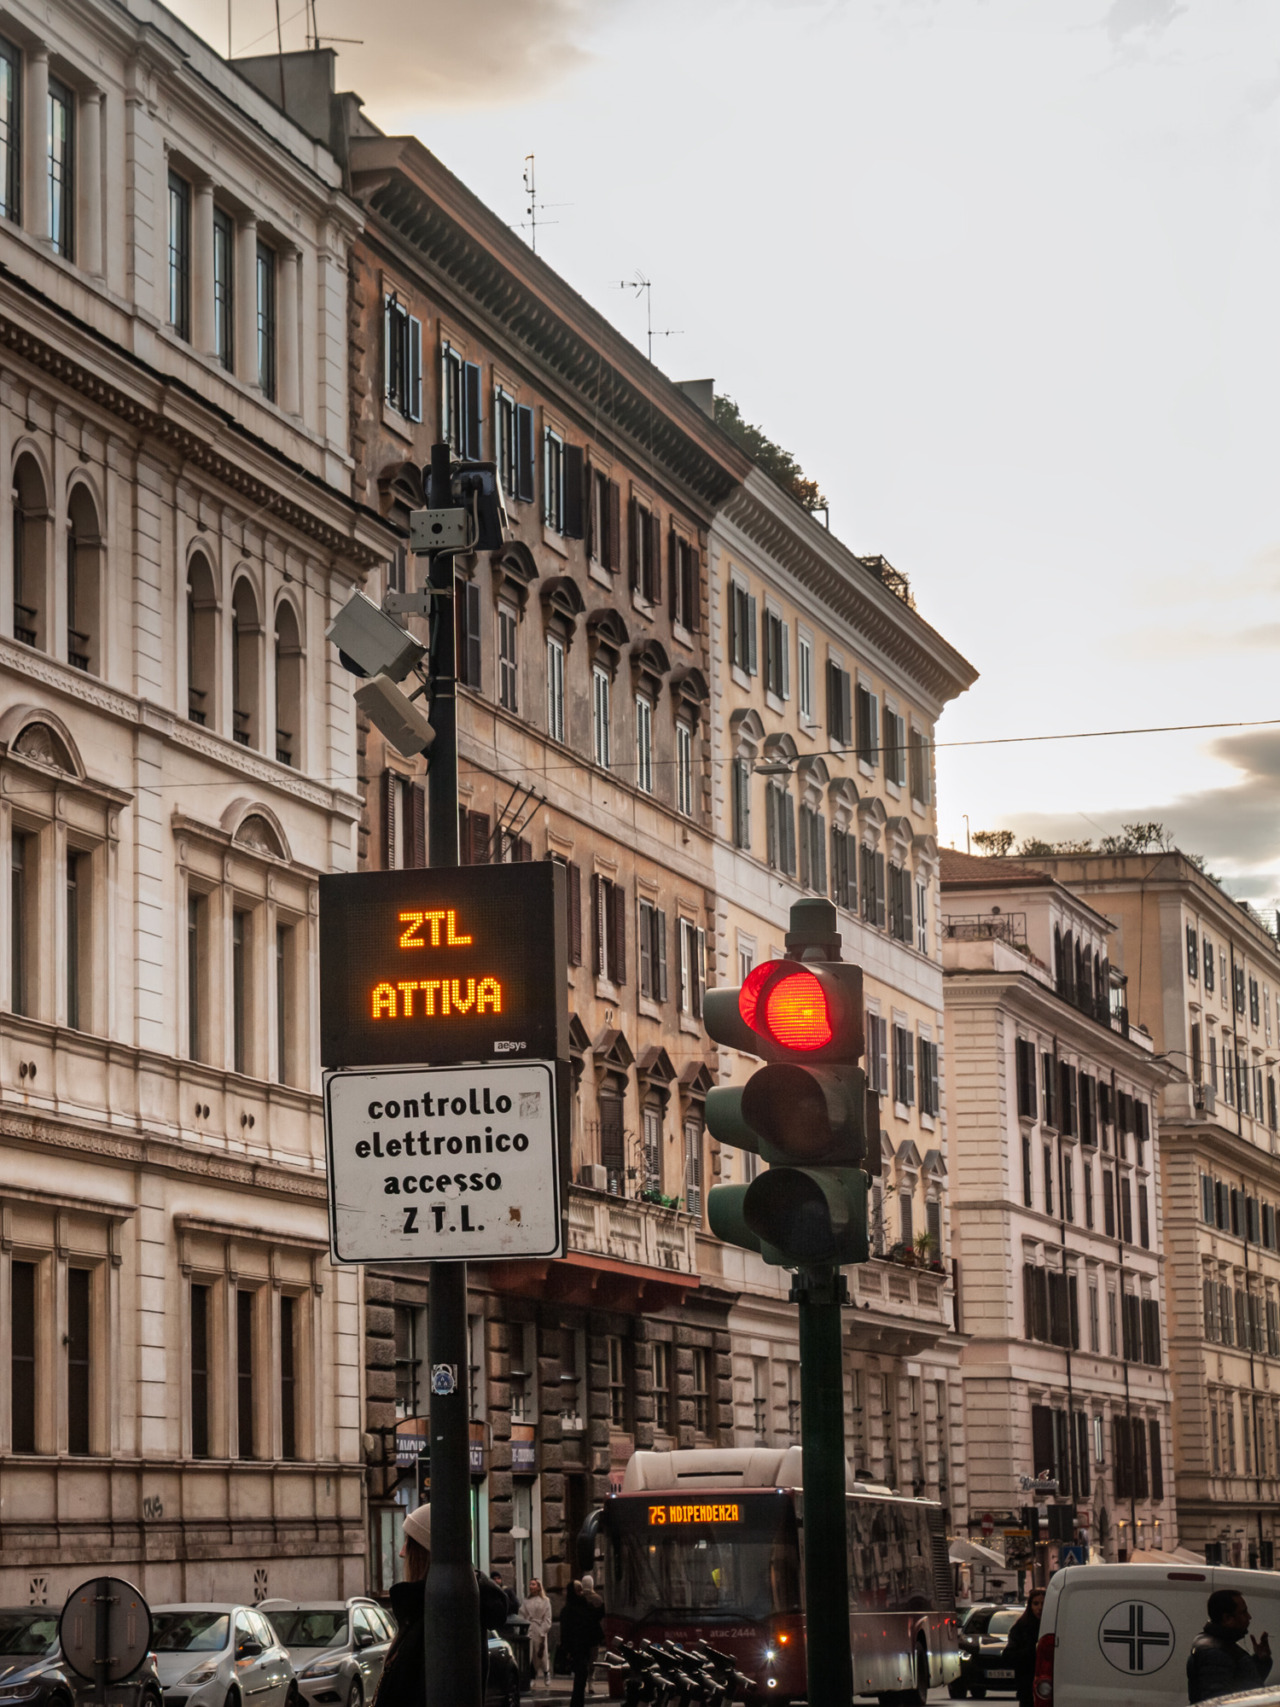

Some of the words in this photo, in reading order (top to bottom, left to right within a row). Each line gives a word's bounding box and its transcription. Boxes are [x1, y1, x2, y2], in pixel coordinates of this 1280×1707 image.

[398, 909, 472, 948] ZTL
[371, 977, 503, 1018] ATTIVA
[497, 1041, 527, 1052] aesys
[368, 1087, 512, 1120] controllo
[355, 1126, 529, 1159] elettronico
[384, 1172, 502, 1195] accesso
[648, 1505, 666, 1525] 75
[710, 1629, 730, 1638] atac
[730, 1628, 756, 1638] 2444
